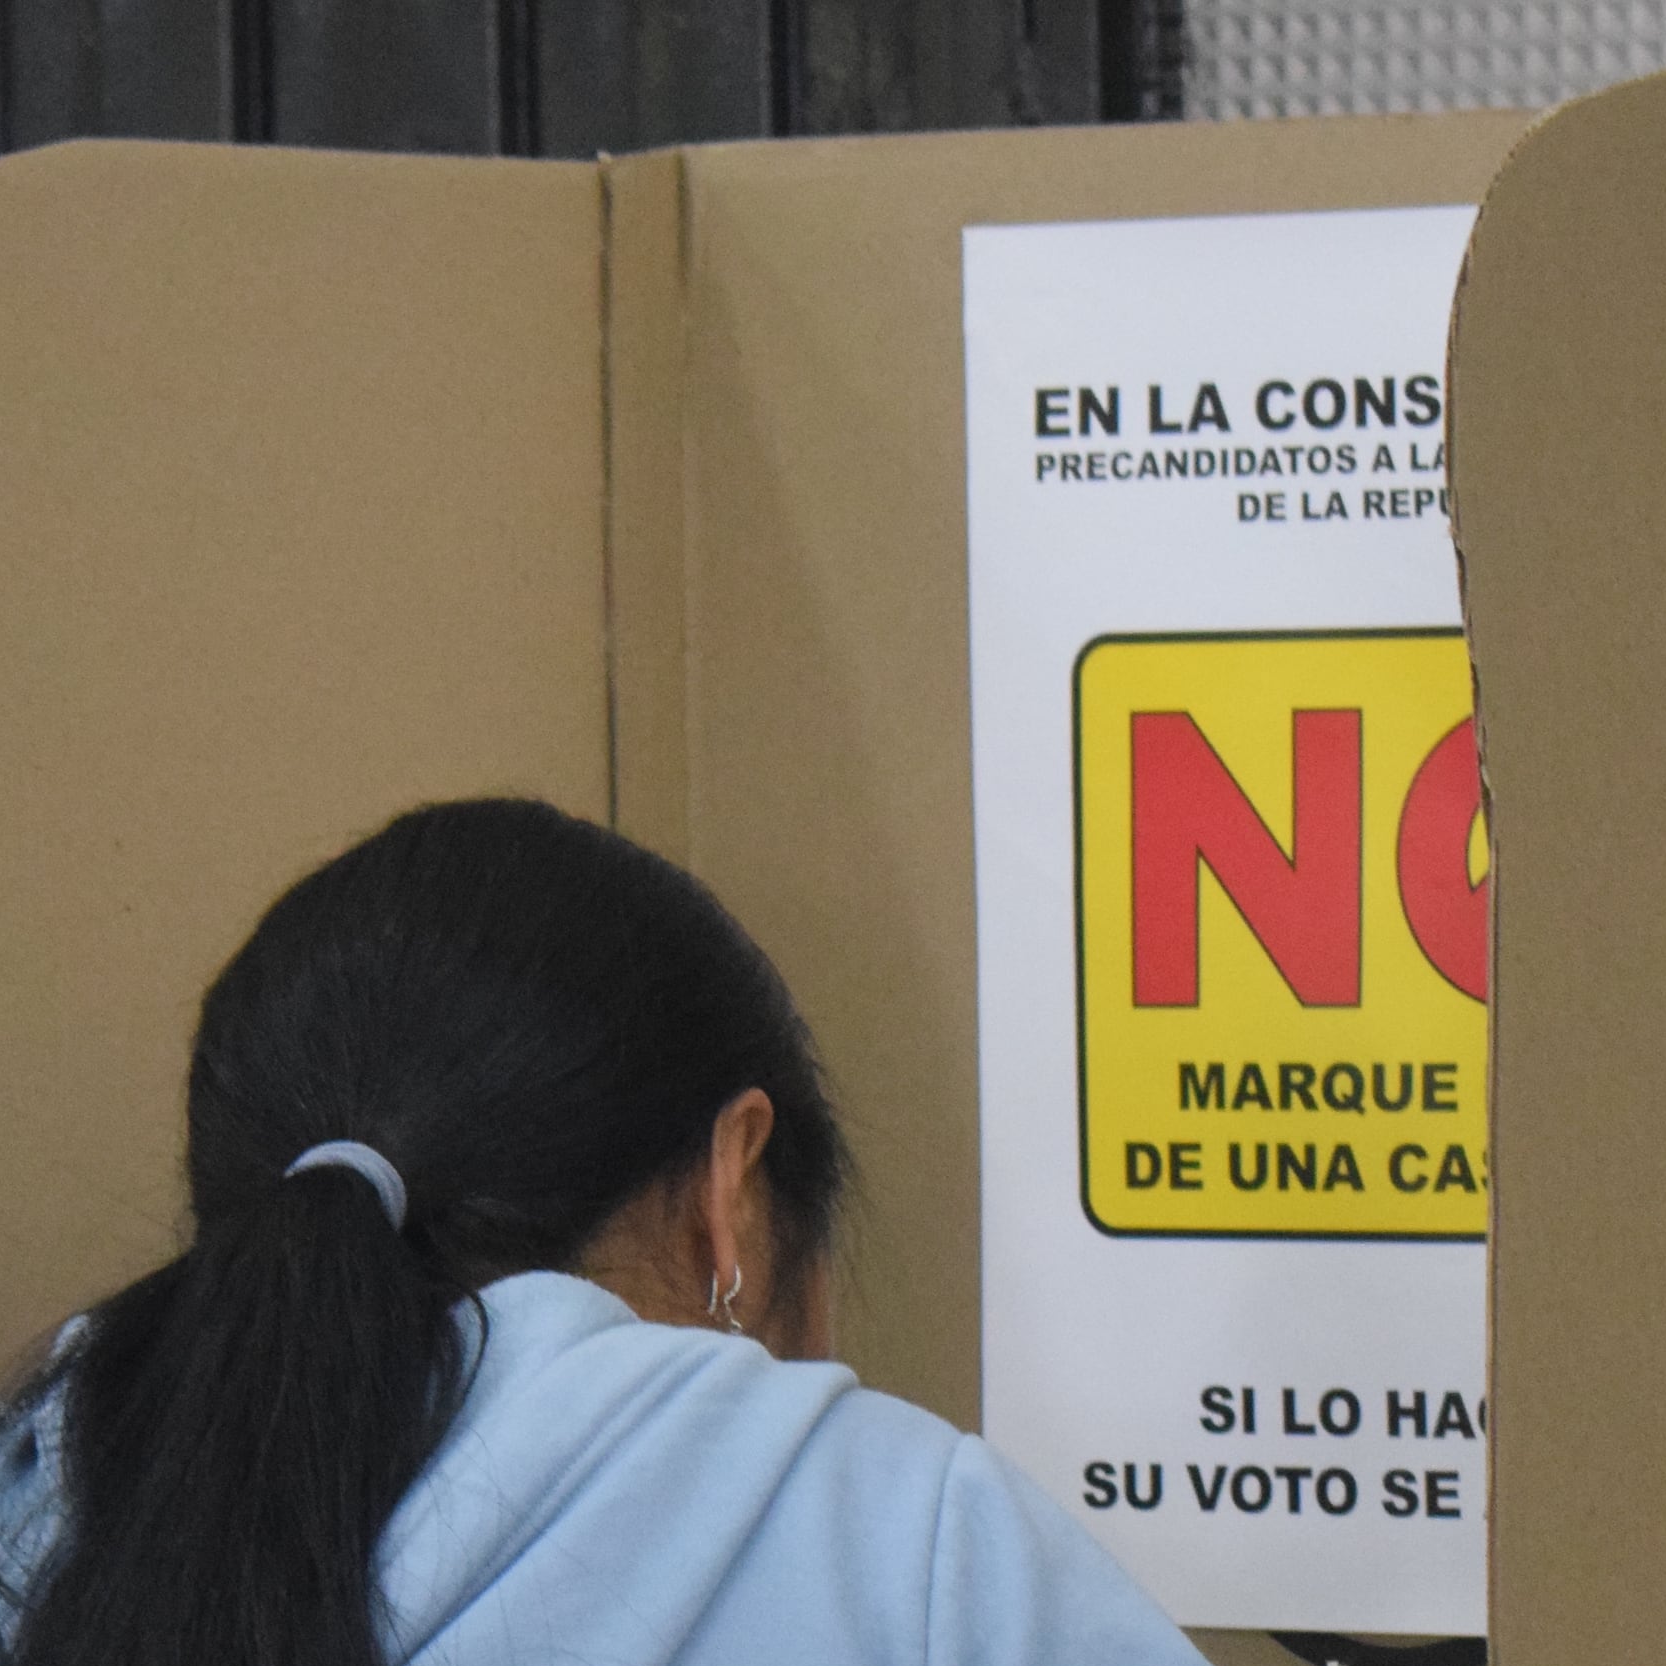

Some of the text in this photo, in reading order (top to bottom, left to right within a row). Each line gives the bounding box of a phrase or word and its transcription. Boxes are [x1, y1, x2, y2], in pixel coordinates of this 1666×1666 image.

[1034, 374, 1443, 438] EN LA CONS
[1035, 442, 1358, 483] PRECANDIDATOS
[1372, 442, 1396, 472] A
[1237, 492, 1287, 522] DE
[1300, 490, 1350, 520] LA
[1177, 1061, 1459, 1115] MARQUE
[1124, 1140, 1487, 1194] DE UNA CA
[1199, 1385, 1487, 1440] SI LO HA
[1082, 1460, 1462, 1519] SU VOTO SE
